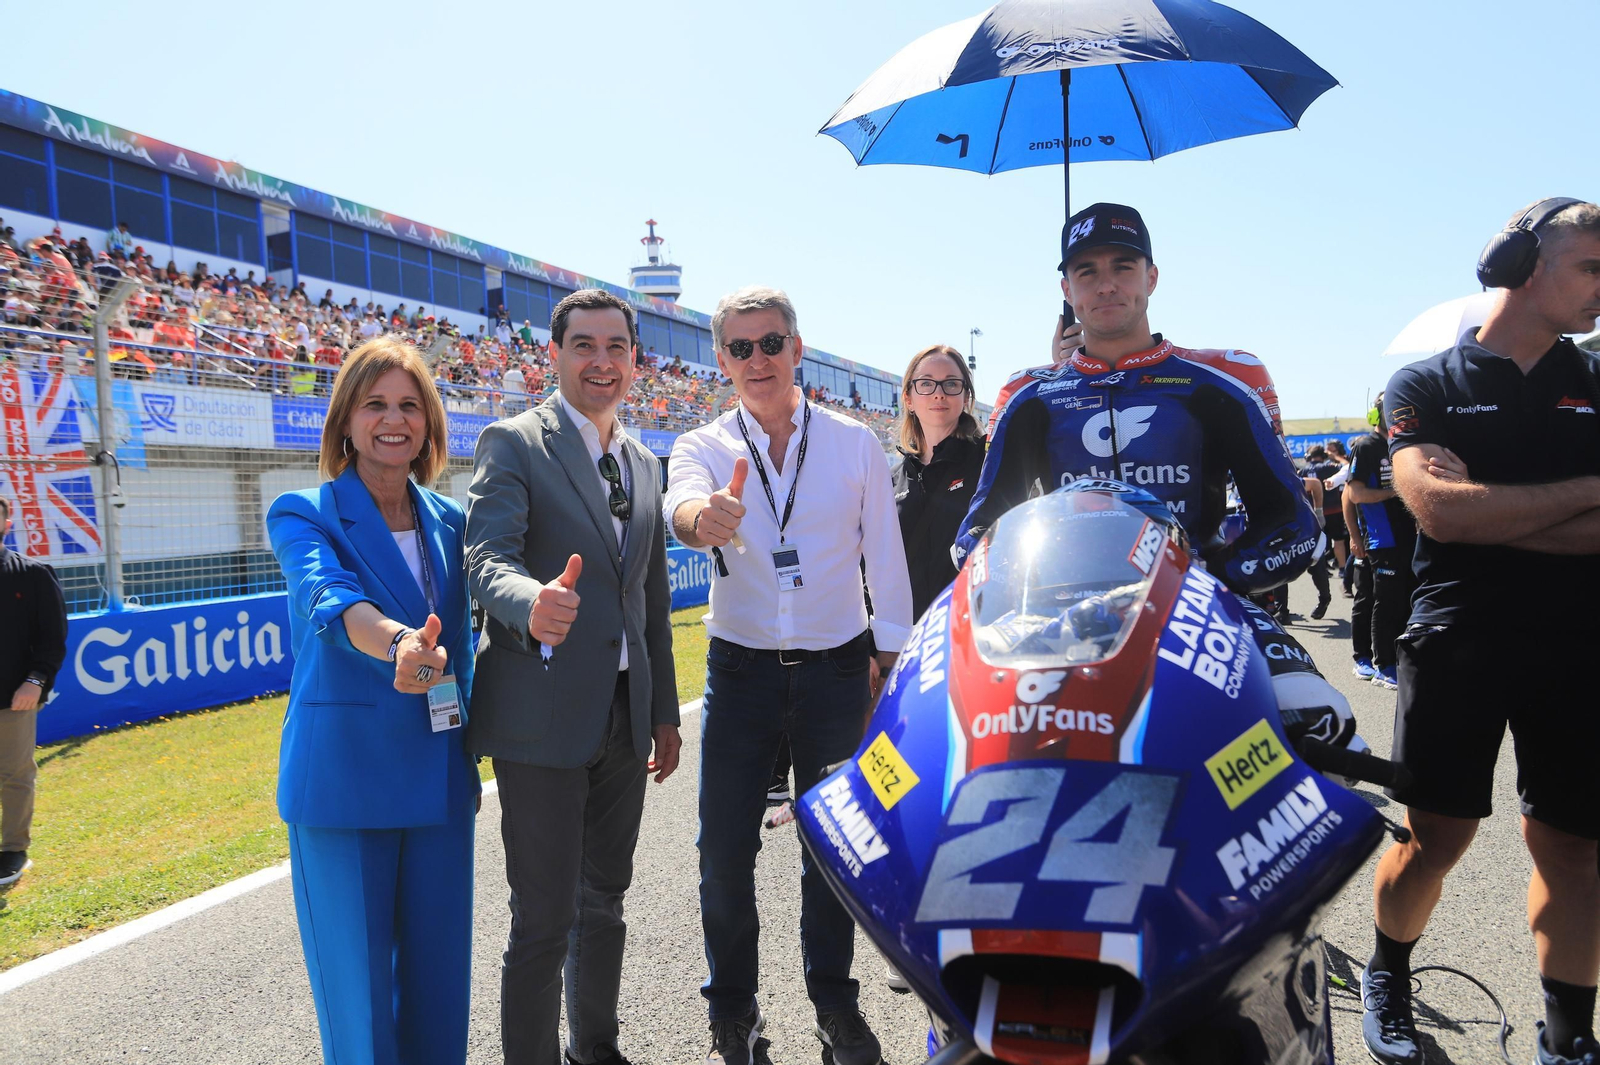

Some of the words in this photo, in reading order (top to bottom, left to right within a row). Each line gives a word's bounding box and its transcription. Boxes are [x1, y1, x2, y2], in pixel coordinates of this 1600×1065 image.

[1067, 215, 1096, 250] 24
[1071, 354, 1103, 370] ACNA
[1124, 342, 1173, 366] MACNA
[183, 394, 257, 418] Diputación
[1036, 378, 1083, 393] FAMILY
[1064, 401, 1083, 410] GENE
[184, 420, 203, 436] de
[207, 419, 245, 439] Cádiz
[288, 410, 325, 429] Cádi
[1456, 403, 1498, 414] OnlyFans
[1130, 521, 1164, 574] WRS
[1264, 537, 1316, 572] OnlyFans
[667, 553, 713, 594] Galici
[1157, 566, 1217, 671] LATAM
[74, 610, 285, 696] Galicia
[1193, 611, 1240, 692] BOX
[971, 703, 1116, 740] OnlyFans
[867, 740, 902, 794] Hertz
[1217, 738, 1279, 795] Hertz
[810, 800, 864, 879] POWERSPORTS
[818, 774, 891, 865] FAMILY
[1216, 775, 1328, 892] FAMILY
[914, 768, 1181, 924] 24
[1248, 810, 1343, 900] POWERSPORTS
